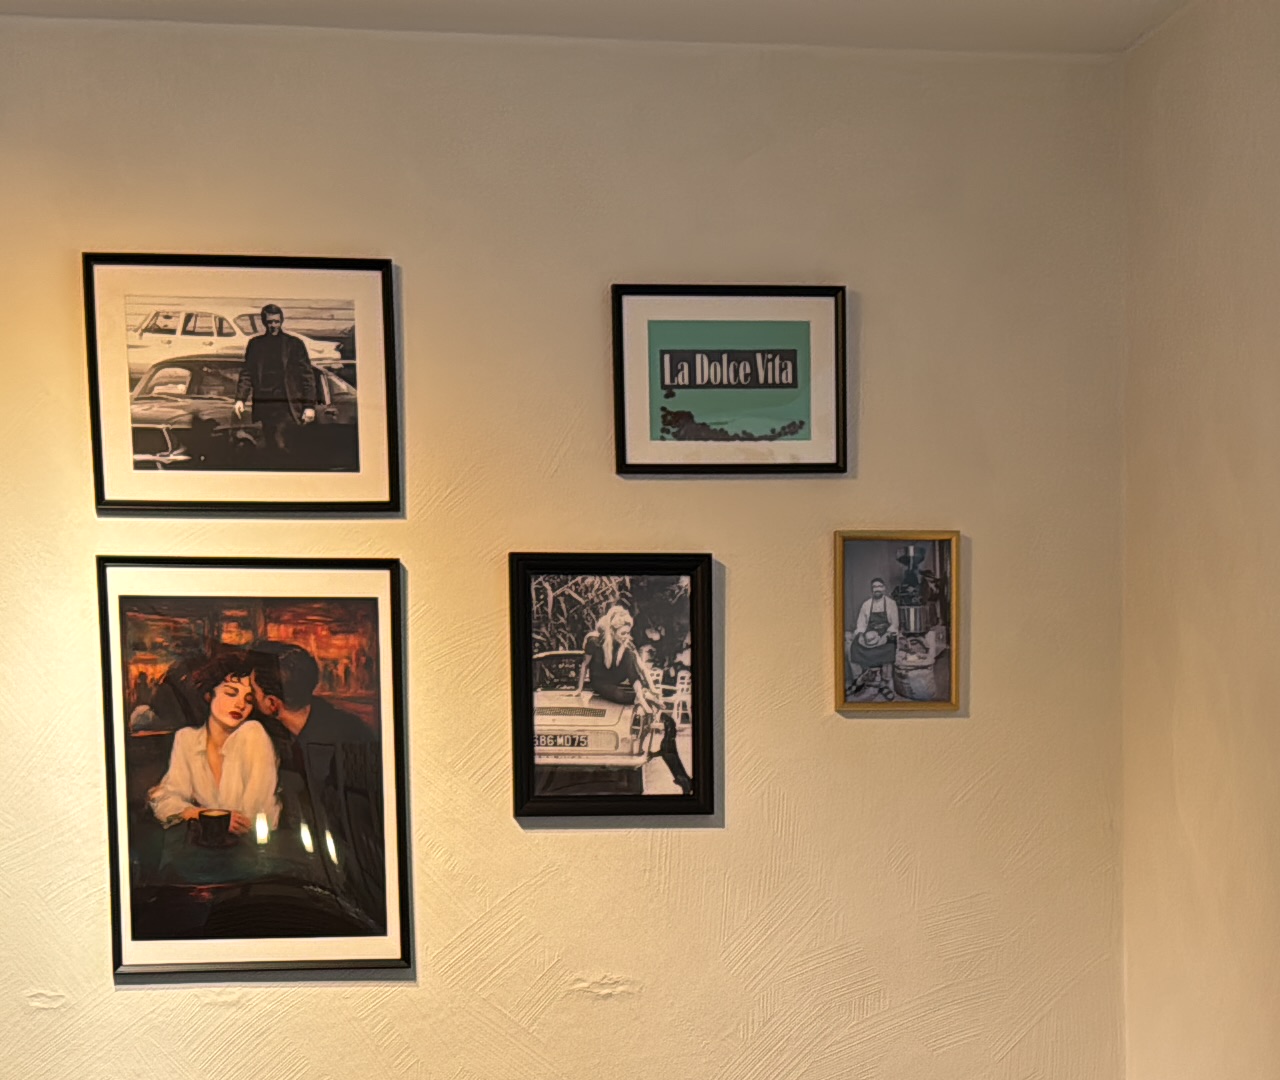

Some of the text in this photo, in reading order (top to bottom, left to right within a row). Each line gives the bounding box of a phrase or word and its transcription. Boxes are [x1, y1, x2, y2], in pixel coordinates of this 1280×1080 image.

[663, 352, 793, 386] La Dolce Vita
